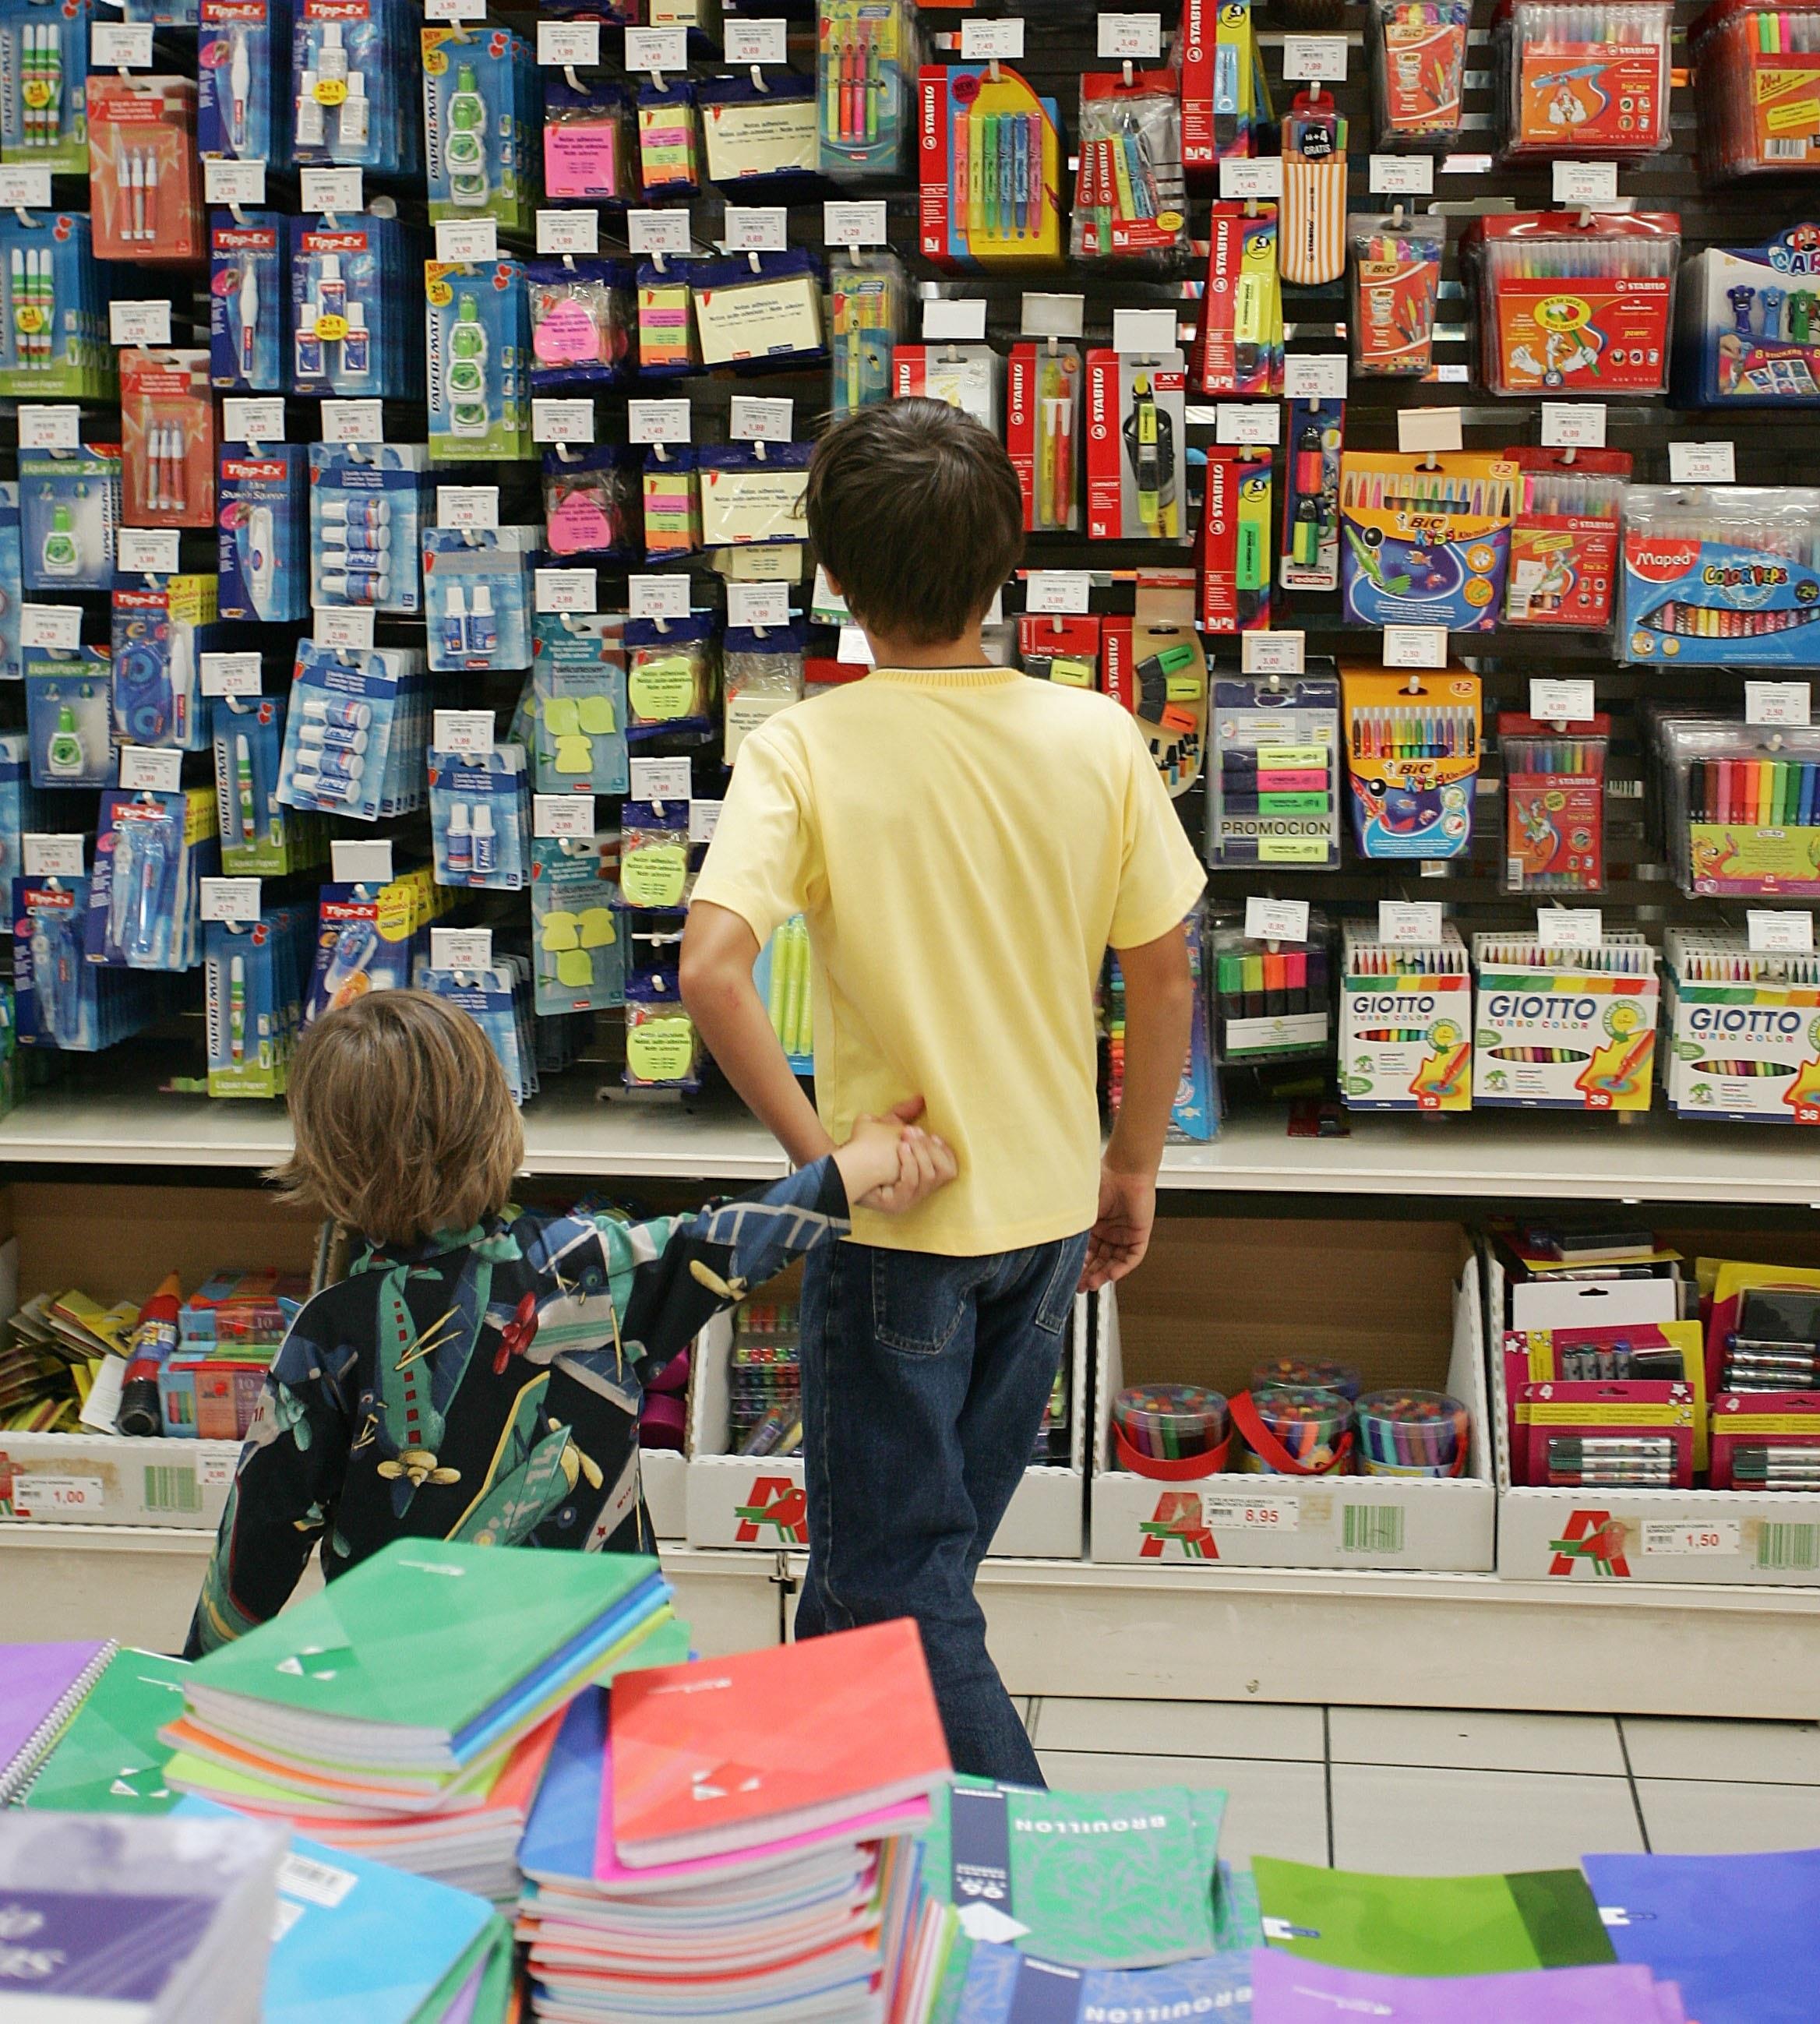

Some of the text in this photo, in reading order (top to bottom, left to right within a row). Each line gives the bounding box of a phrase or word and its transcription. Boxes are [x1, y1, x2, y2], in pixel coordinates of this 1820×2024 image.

[206, 4, 266, 16] Tipp-Ex
[310, 3, 365, 16] Tipp-Ex
[924, 86, 935, 135] STABILO
[1304, 144, 1331, 156] GRATIS
[1099, 143, 1108, 189] STABILO
[218, 233, 270, 245] Tipp-Ex
[308, 236, 362, 249] Tipp-Ex
[1216, 221, 1229, 274] STABILO
[899, 364, 910, 396] BILO
[1014, 364, 1023, 410] STABILO
[1093, 368, 1104, 421] STABILO
[227, 464, 282, 477] Tipp-Ex
[1494, 464, 1511, 474] 12
[1212, 464, 1224, 517] STABILO
[1637, 552, 1691, 567] Maped
[118, 594, 167, 605] Tipp-Ex
[1109, 637, 1119, 689] STABILO
[1455, 682, 1473, 692] 12
[1221, 821, 1331, 835] PROMOCION
[326, 905, 373, 917] Tipp-Ex
[1353, 996, 1435, 1014] GIOTTO
[1489, 995, 1597, 1021] GIOTTO
[1487, 1018, 1589, 1030] TURBO COLOR
[1690, 1008, 1801, 1034] GIOTTO
[1689, 1031, 1794, 1043] TURBO COLOR
[1589, 1095, 1608, 1106] 36
[1799, 1109, 1819, 1120] 36
[1539, 1384, 1554, 1400] 4
[1726, 1398, 1740, 1411] 4
[53, 1490, 84, 1504] 1,00
[1245, 1508, 1279, 1523] 8,95
[1686, 1532, 1720, 1547] 1,50
[1014, 1815, 1166, 1834] BROUILLON
[1085, 1986, 1253, 2024] BROUILLON
